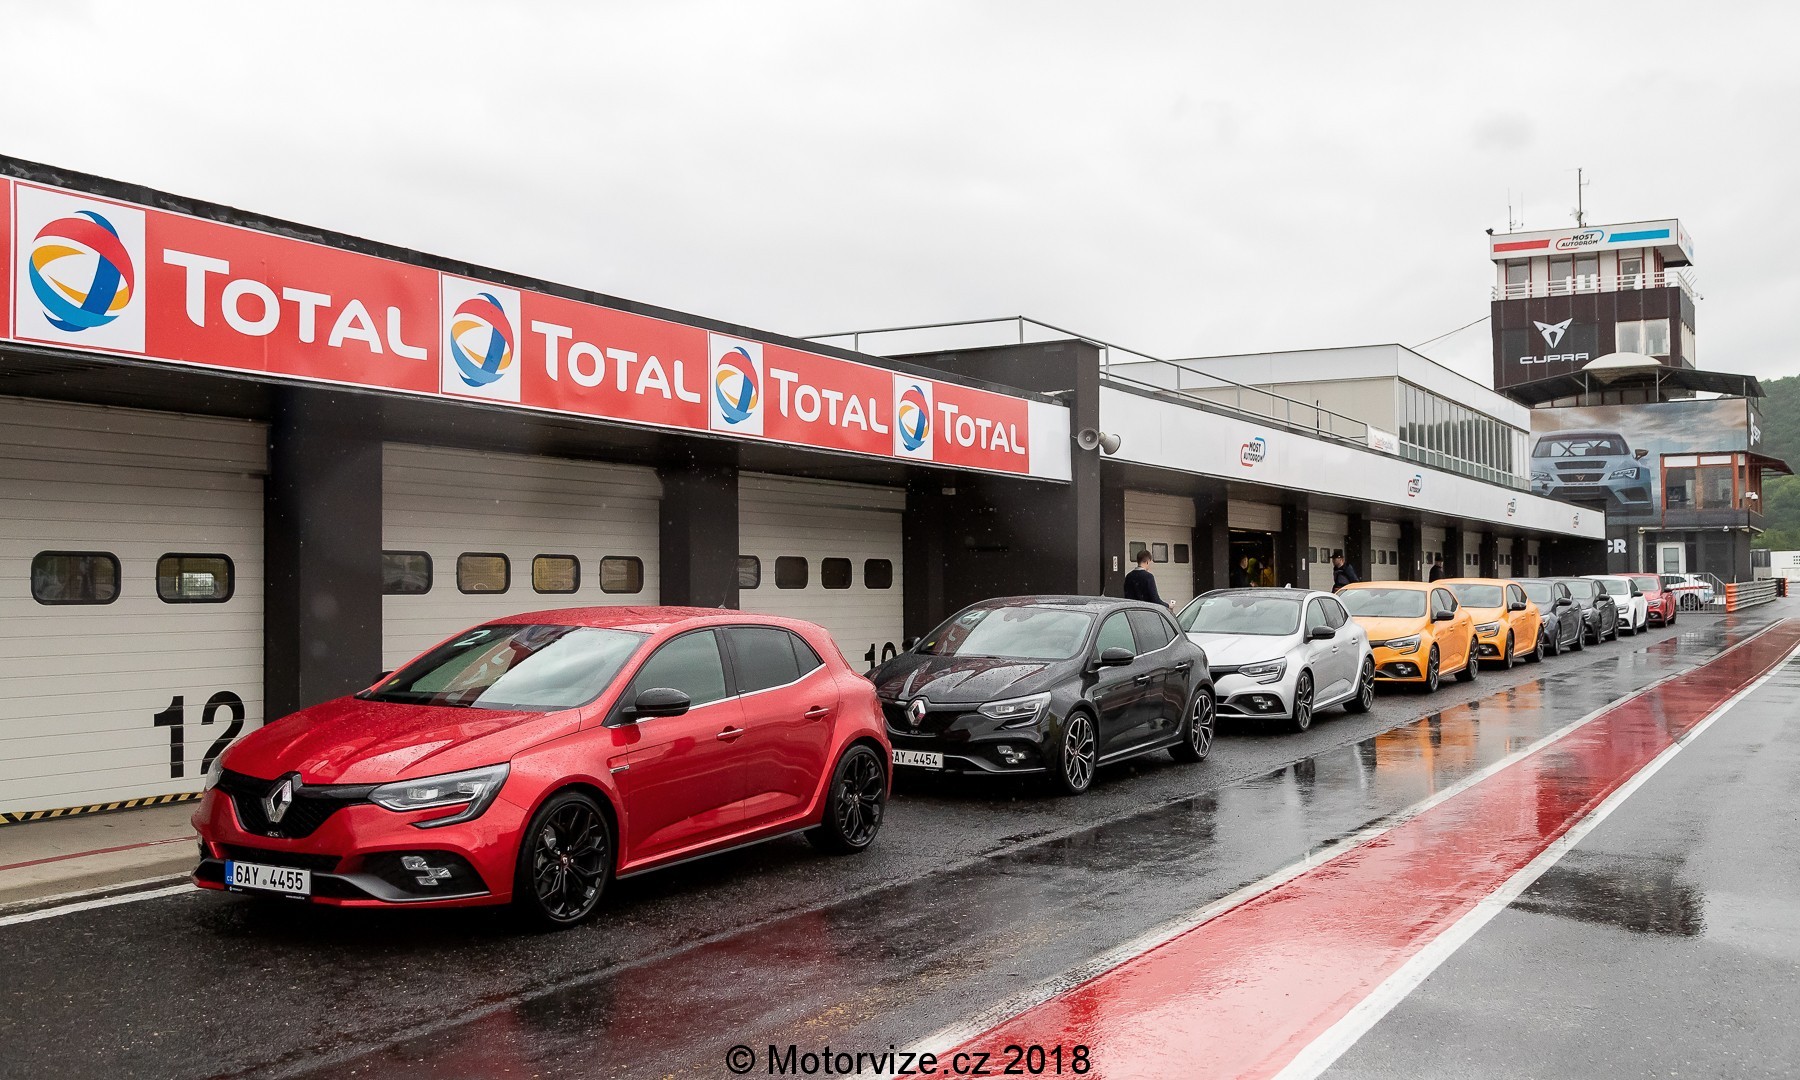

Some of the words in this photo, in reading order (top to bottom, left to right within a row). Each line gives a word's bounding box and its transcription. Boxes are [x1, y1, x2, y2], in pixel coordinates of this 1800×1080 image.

[1561, 240, 1599, 248] AUTODROM
[1572, 233, 1595, 241] MOST
[163, 248, 428, 361] TOTAL
[531, 319, 702, 404] TOTAL
[1519, 352, 1589, 365] CUPRA
[769, 367, 889, 434] TOTAL
[937, 401, 1026, 456] TOTAL
[1249, 441, 1262, 453] MOST
[153, 690, 246, 779] 12
[913, 753, 938, 766] 4454
[236, 865, 260, 886] 6AY
[269, 869, 304, 891] 4455
